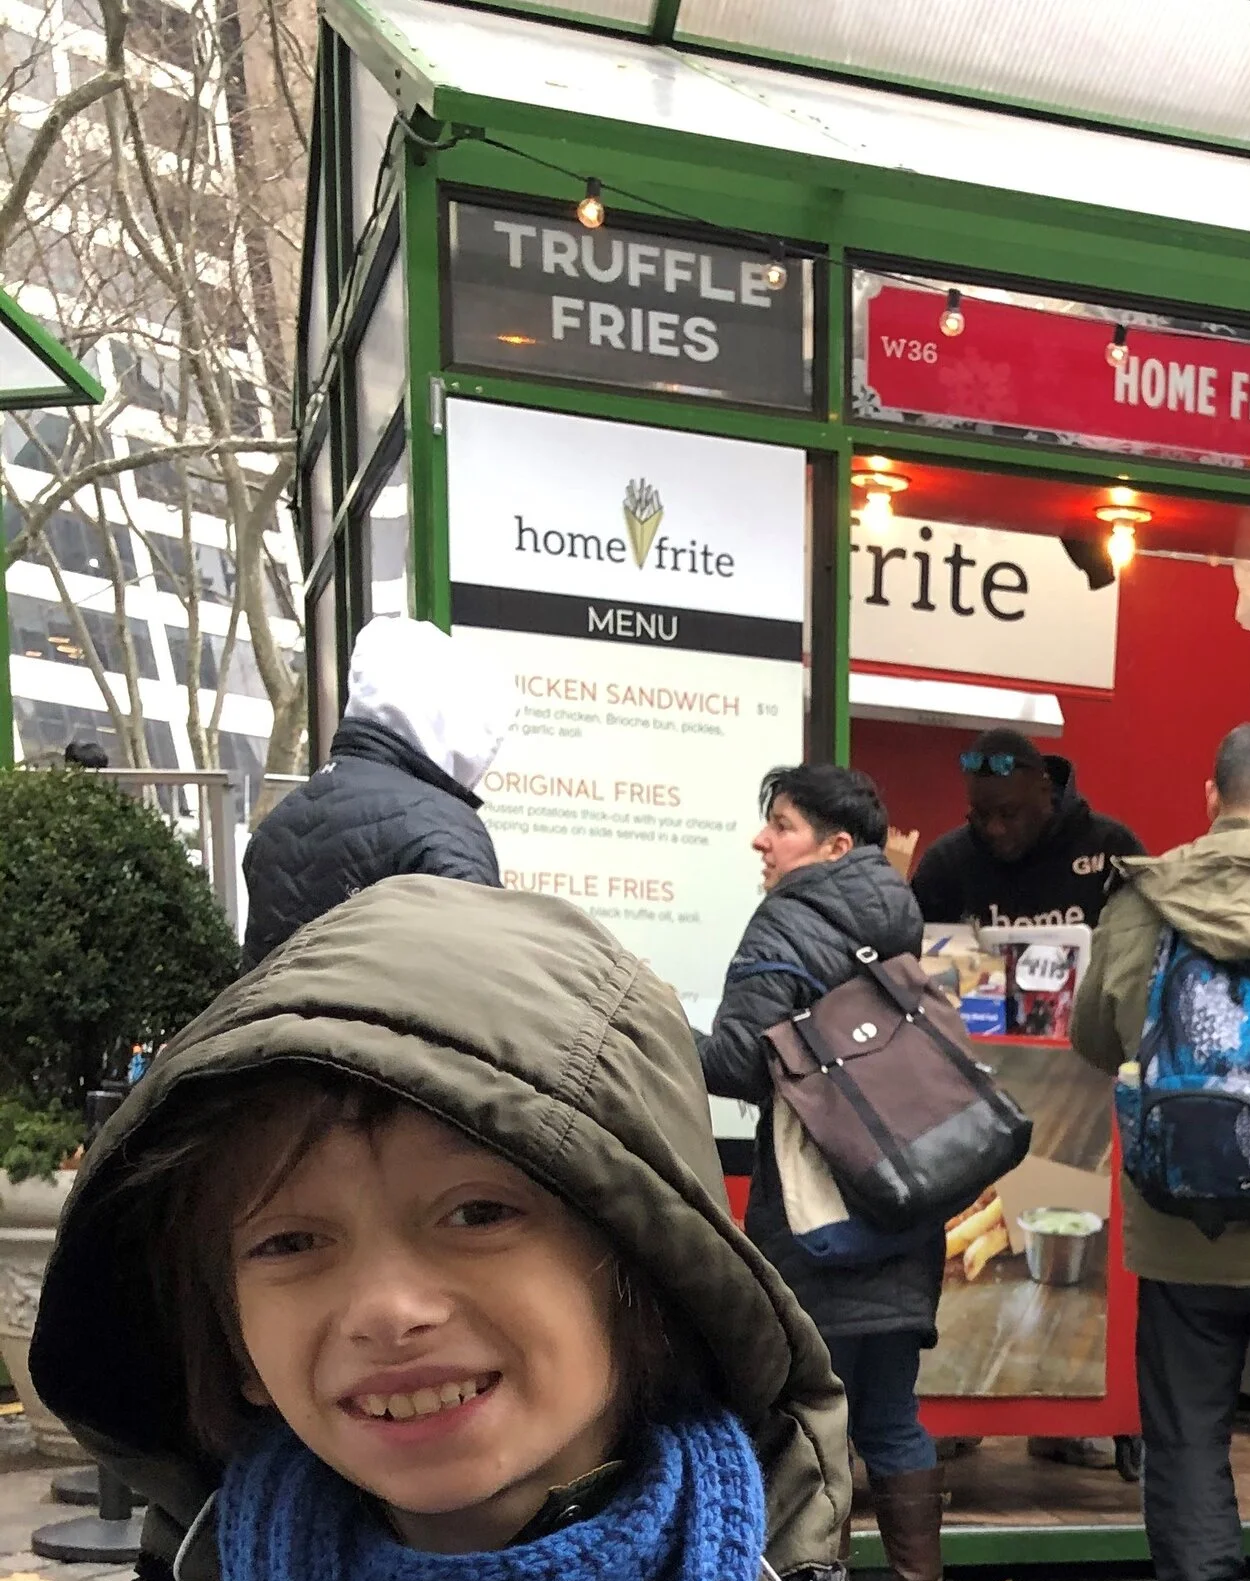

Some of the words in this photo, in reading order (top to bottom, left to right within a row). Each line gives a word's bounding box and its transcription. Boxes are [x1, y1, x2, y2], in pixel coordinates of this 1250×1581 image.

[494, 221, 772, 307] TRUFFLE
[551, 295, 720, 362] FRIES
[881, 335, 938, 364] W36
[1114, 356, 1218, 417] HOME
[515, 516, 626, 564] home
[654, 537, 735, 578] frite
[850, 517, 1028, 621] rite
[588, 607, 679, 642] MENU
[606, 683, 740, 717] SANDWICH
[484, 771, 604, 801] ORIGINAL
[614, 781, 682, 807] FRIES
[504, 870, 599, 898] RUFFLE
[608, 876, 675, 902] FRIES
[989, 903, 1084, 927] home
